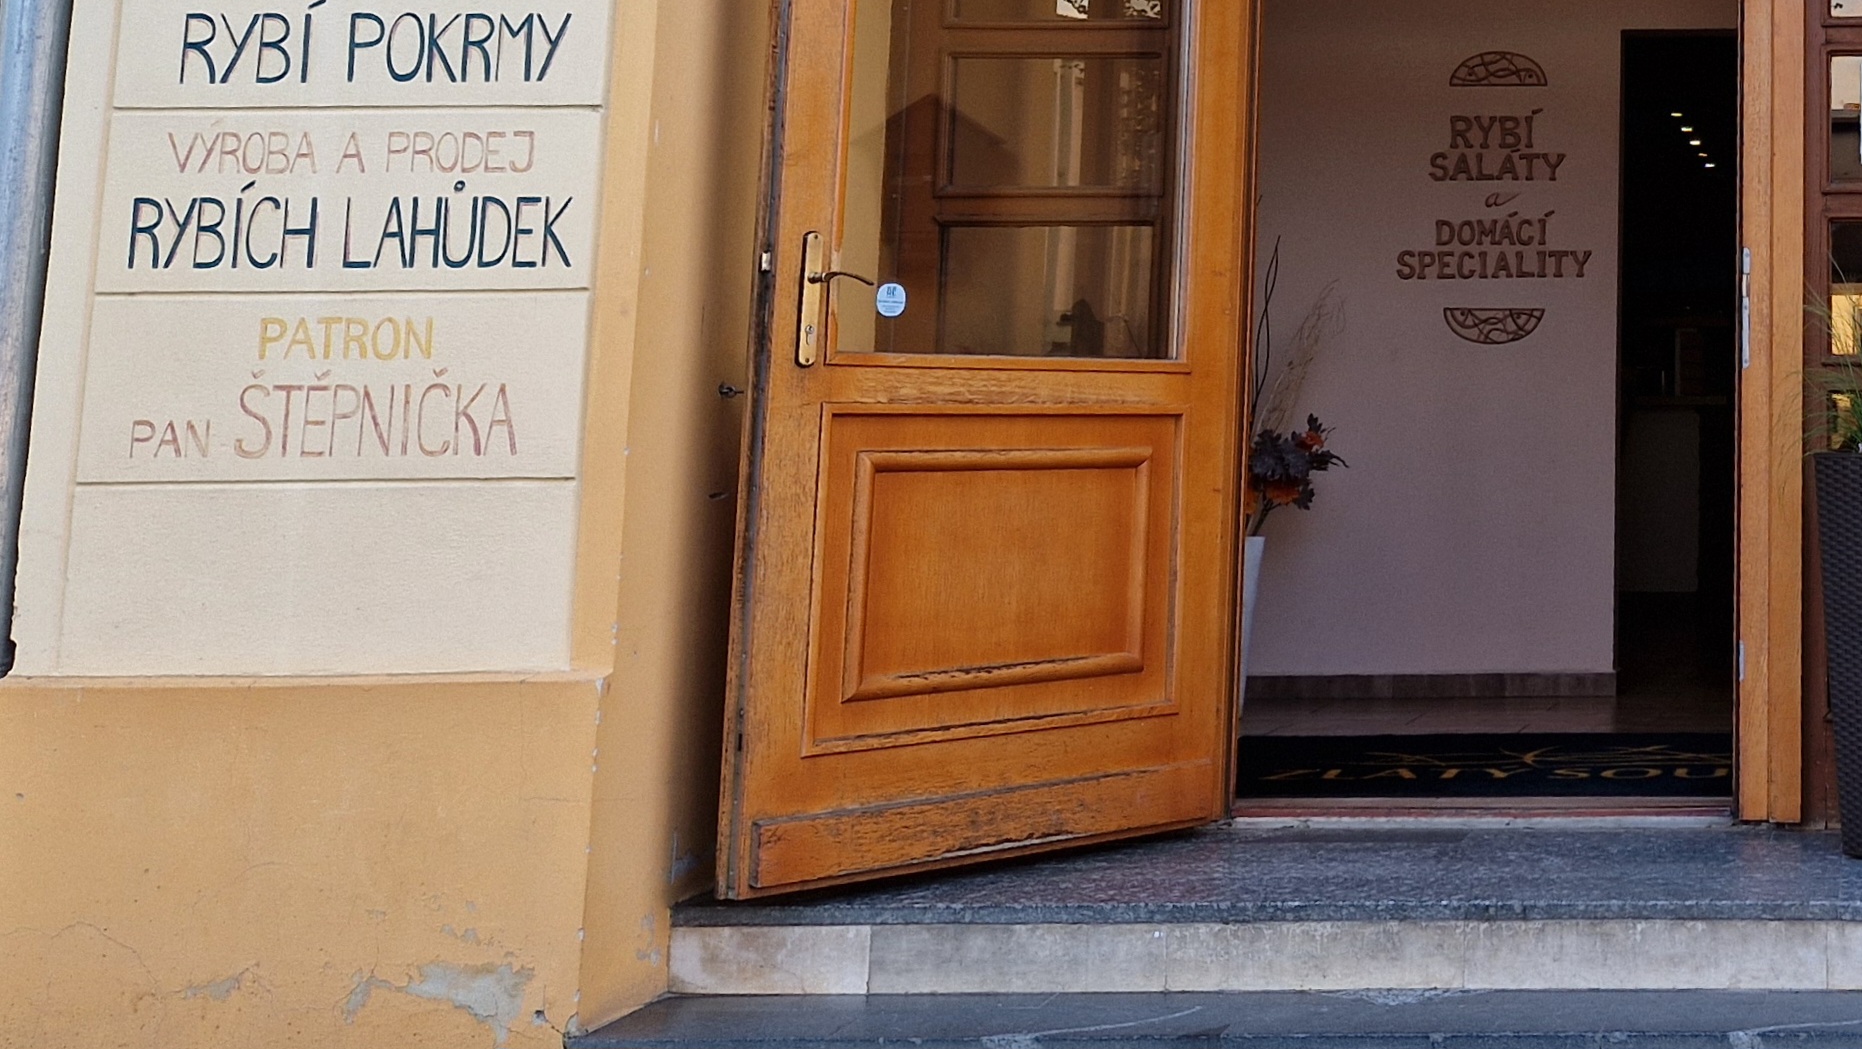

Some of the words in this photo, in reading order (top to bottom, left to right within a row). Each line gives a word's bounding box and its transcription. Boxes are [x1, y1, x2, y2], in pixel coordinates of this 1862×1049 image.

[347, 12, 572, 84] POKRMY
[167, 120, 317, 174] VÝROBA
[338, 131, 367, 174] A
[385, 129, 535, 174] PRODEJ
[1449, 108, 1543, 149] RYBÍ
[1428, 149, 1567, 181] SALÁTY
[126, 180, 319, 269] RYBÍCH
[342, 179, 573, 269] LAHŮDEK
[1435, 210, 1556, 246] DOMÁCÍ
[1396, 250, 1593, 280] SPECIALITY
[257, 316, 434, 361] PATRON
[128, 419, 211, 459] PAN
[232, 367, 518, 459] ŠTĚPNIČKA
